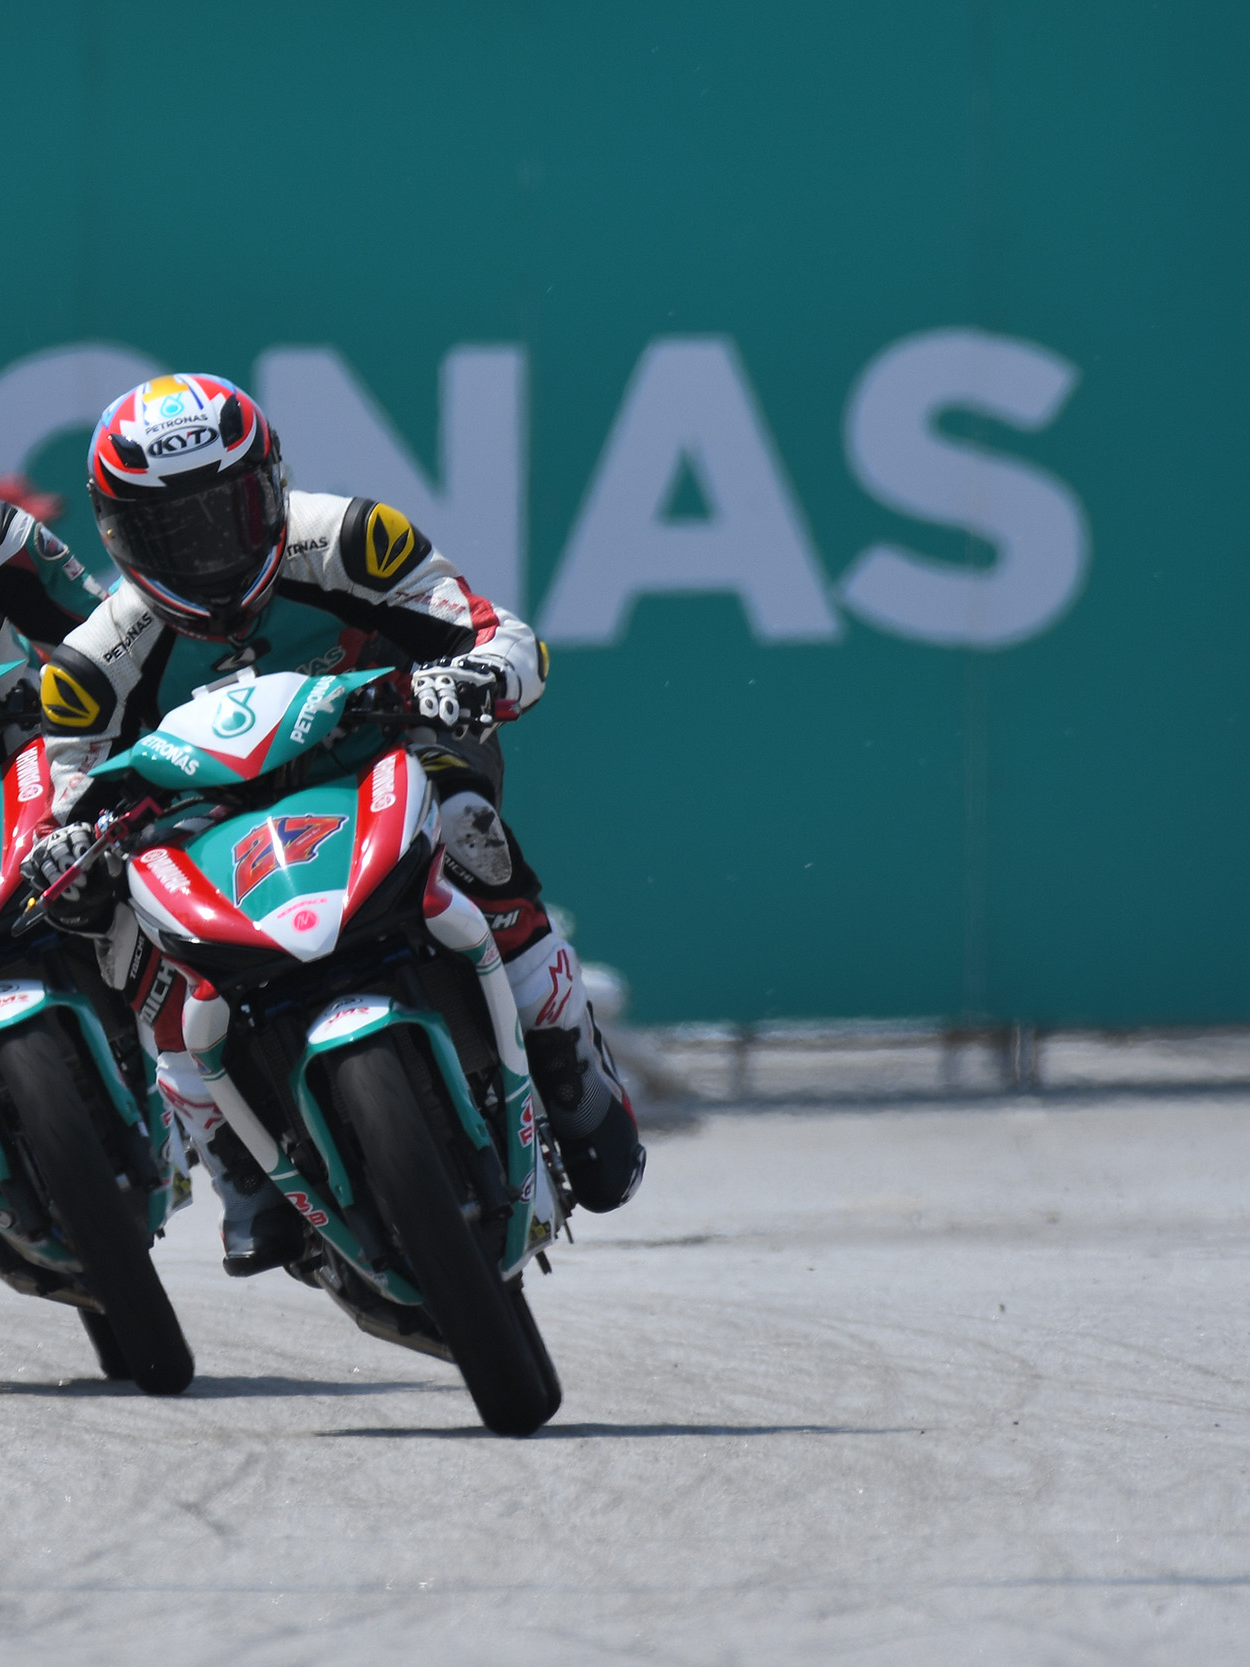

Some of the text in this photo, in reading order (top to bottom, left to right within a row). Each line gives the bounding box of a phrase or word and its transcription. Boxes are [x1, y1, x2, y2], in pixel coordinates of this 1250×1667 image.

[145, 414, 208, 435] PETRONAS
[149, 427, 218, 456] KYT
[232, 814, 349, 908] 27
